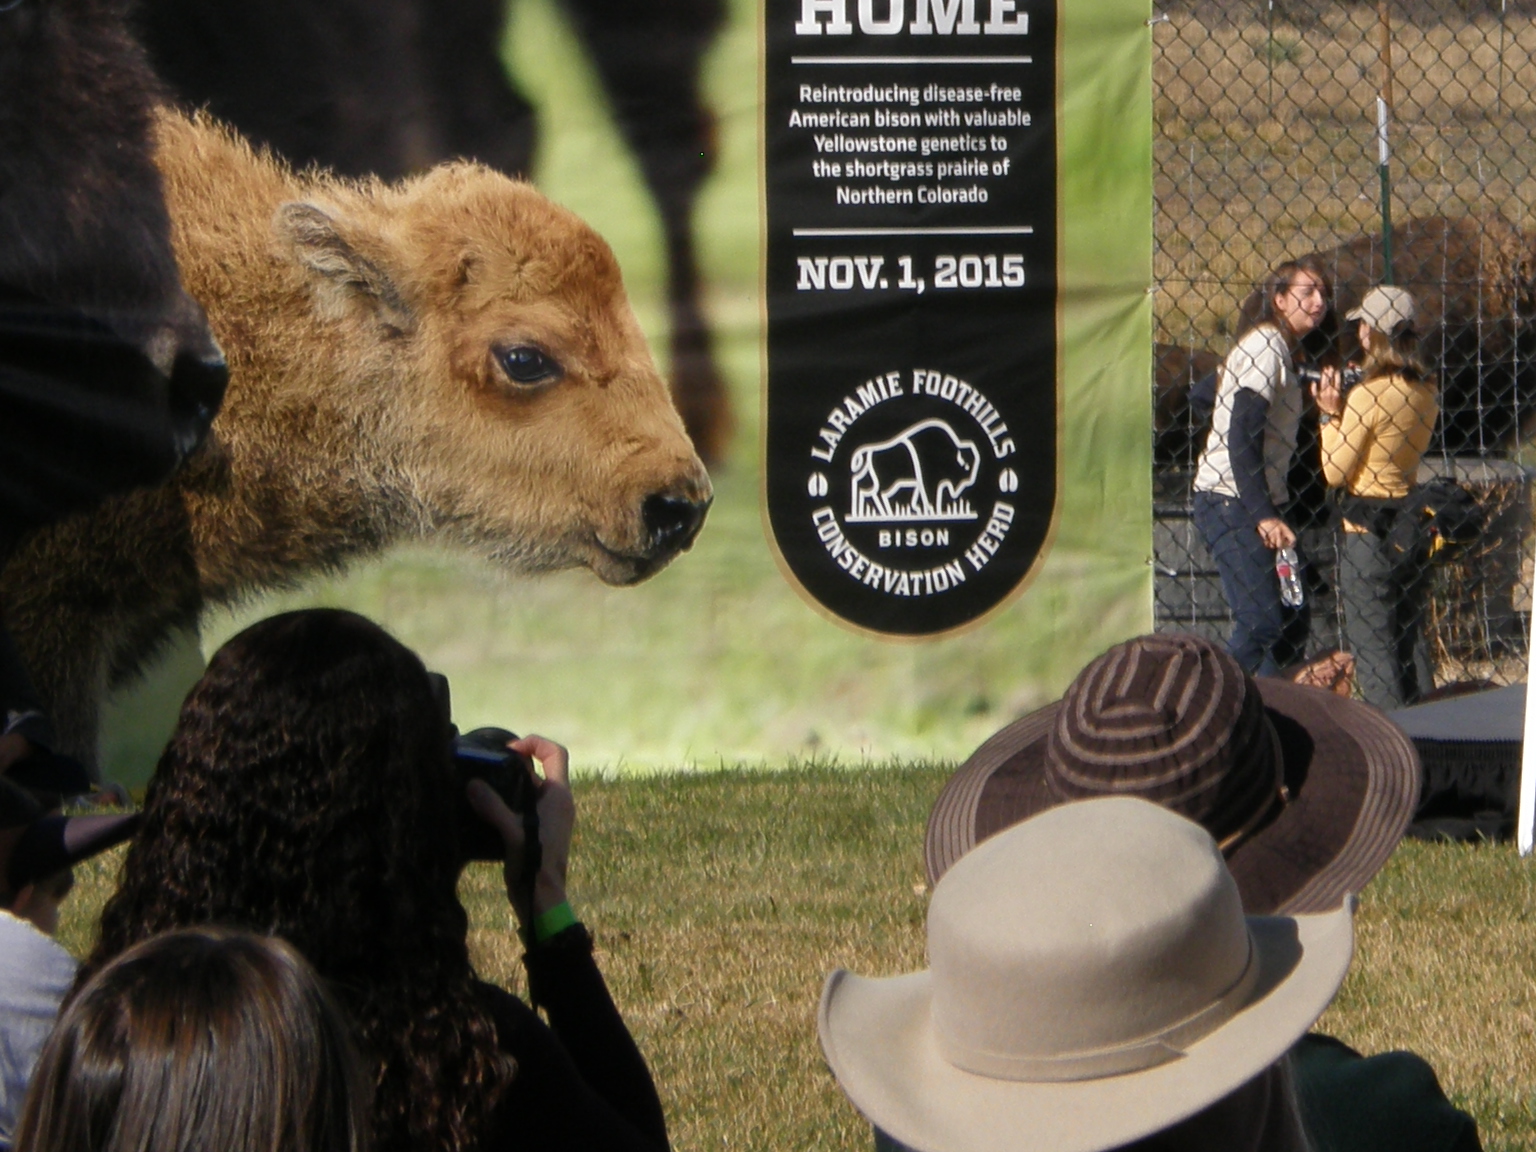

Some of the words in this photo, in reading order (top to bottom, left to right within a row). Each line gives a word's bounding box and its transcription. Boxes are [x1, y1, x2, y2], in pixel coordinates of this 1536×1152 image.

[799, 83, 919, 106] Reintroducing
[923, 82, 1022, 103] disease-free
[789, 109, 870, 128] American
[874, 108, 921, 128] bison
[924, 108, 960, 127] with
[964, 108, 1032, 127] valuable
[813, 133, 917, 153] Yellowstone
[921, 133, 986, 156] genetics
[990, 134, 1008, 151] to
[812, 158, 841, 178] the
[845, 158, 934, 181] shortgrass
[937, 157, 988, 180] prairie
[992, 157, 1011, 176] of
[836, 185, 913, 205] Northern
[917, 184, 988, 204] Colorado
[796, 255, 888, 290] NOV.
[898, 255, 925, 294] 1,
[934, 254, 1025, 288] 2015
[811, 370, 904, 463] LARAMIE
[912, 369, 1016, 459] FOOTHILLS
[812, 505, 967, 597] CONSERVATION
[964, 501, 1016, 572] HERD
[879, 528, 950, 548] BISON
